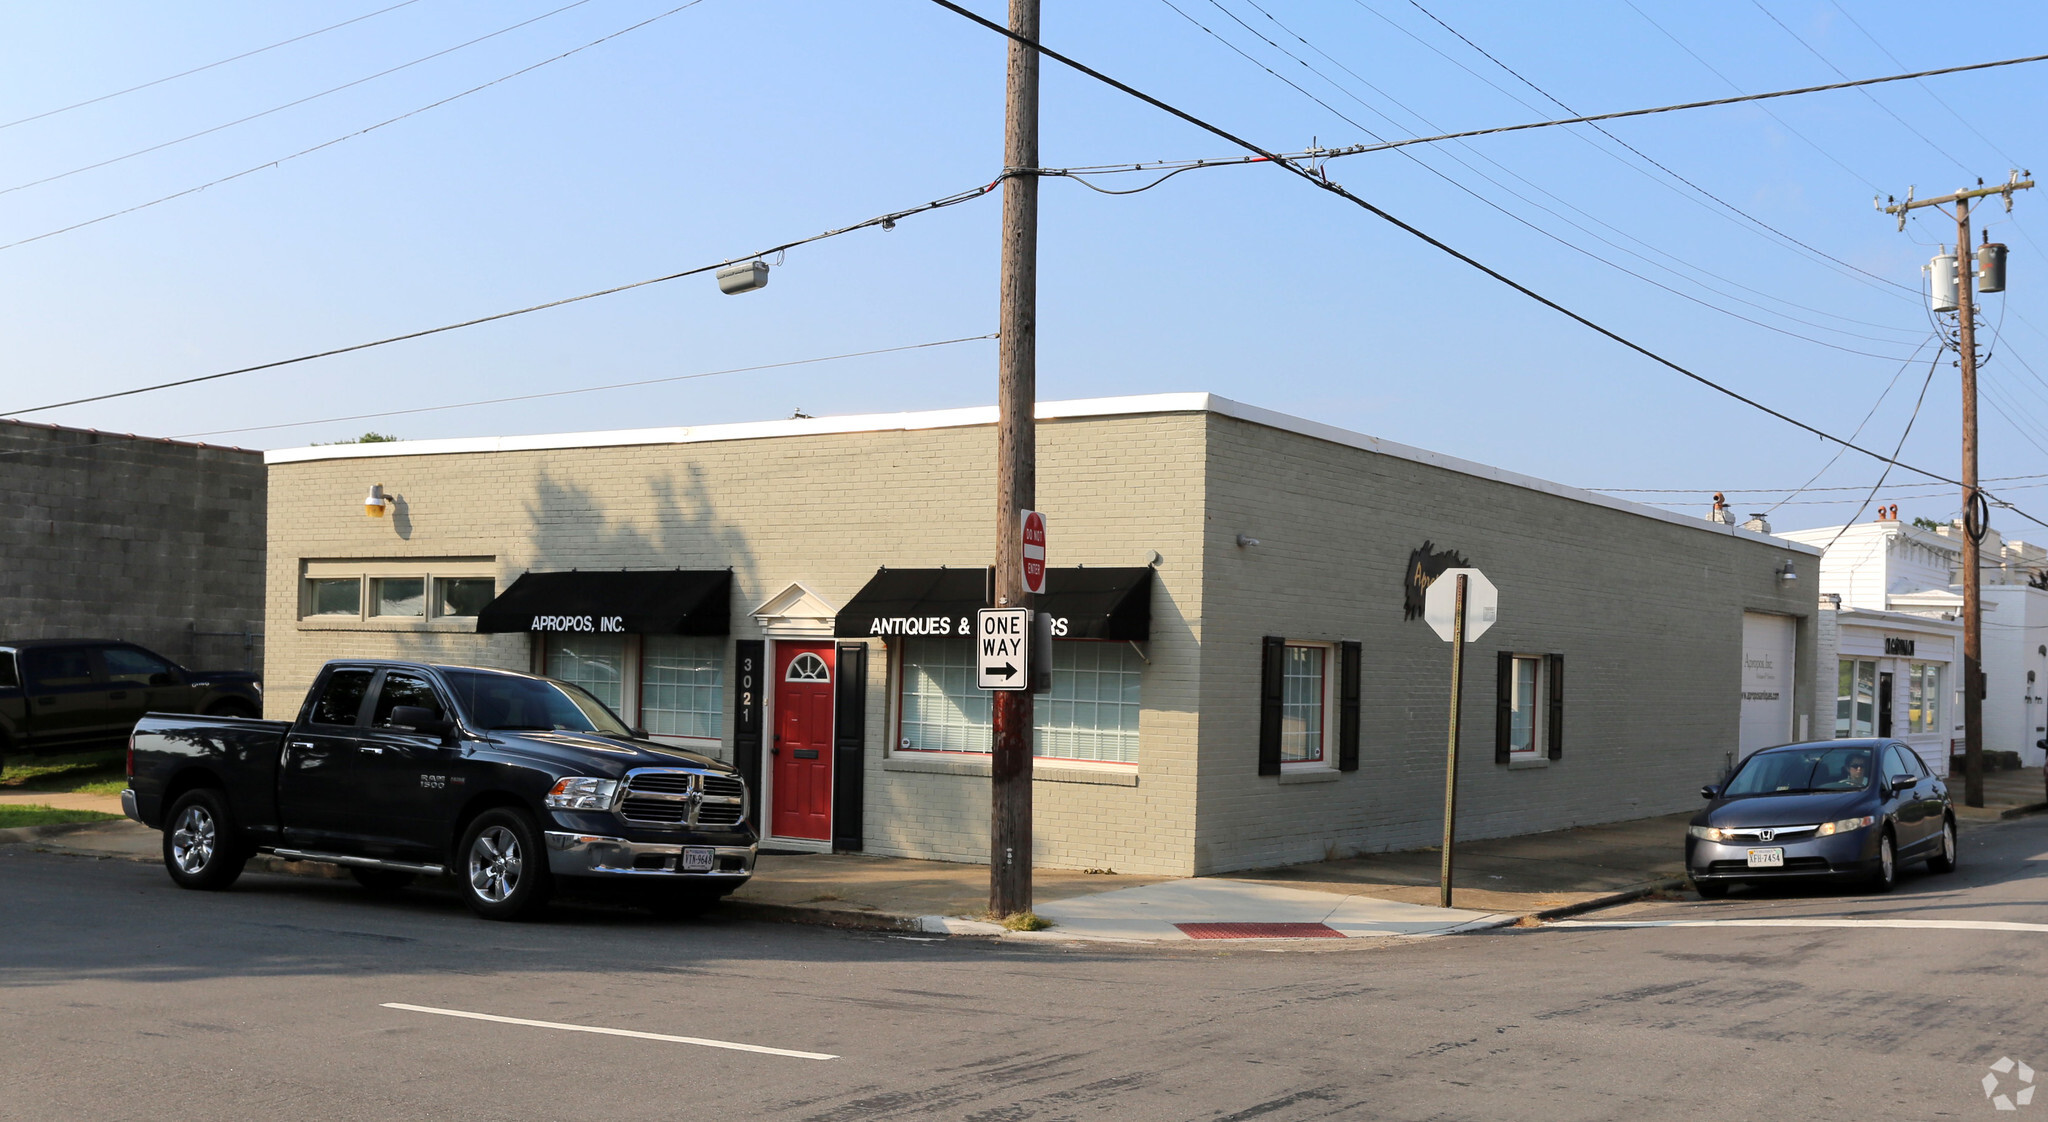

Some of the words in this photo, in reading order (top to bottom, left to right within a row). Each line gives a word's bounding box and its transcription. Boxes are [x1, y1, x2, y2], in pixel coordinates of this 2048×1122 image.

[1026, 528, 1033, 540] DO
[1034, 529, 1043, 542] NOT
[1027, 562, 1041, 575] ENTER
[531, 615, 594, 633] APROPOS,
[600, 615, 625, 633] INC.
[870, 616, 951, 636] ANTIQUES
[958, 617, 970, 635] &
[985, 616, 1020, 634] ONE
[983, 638, 1021, 656] WAY
[743, 658, 752, 722] 3021
[420, 781, 445, 789] 1500
